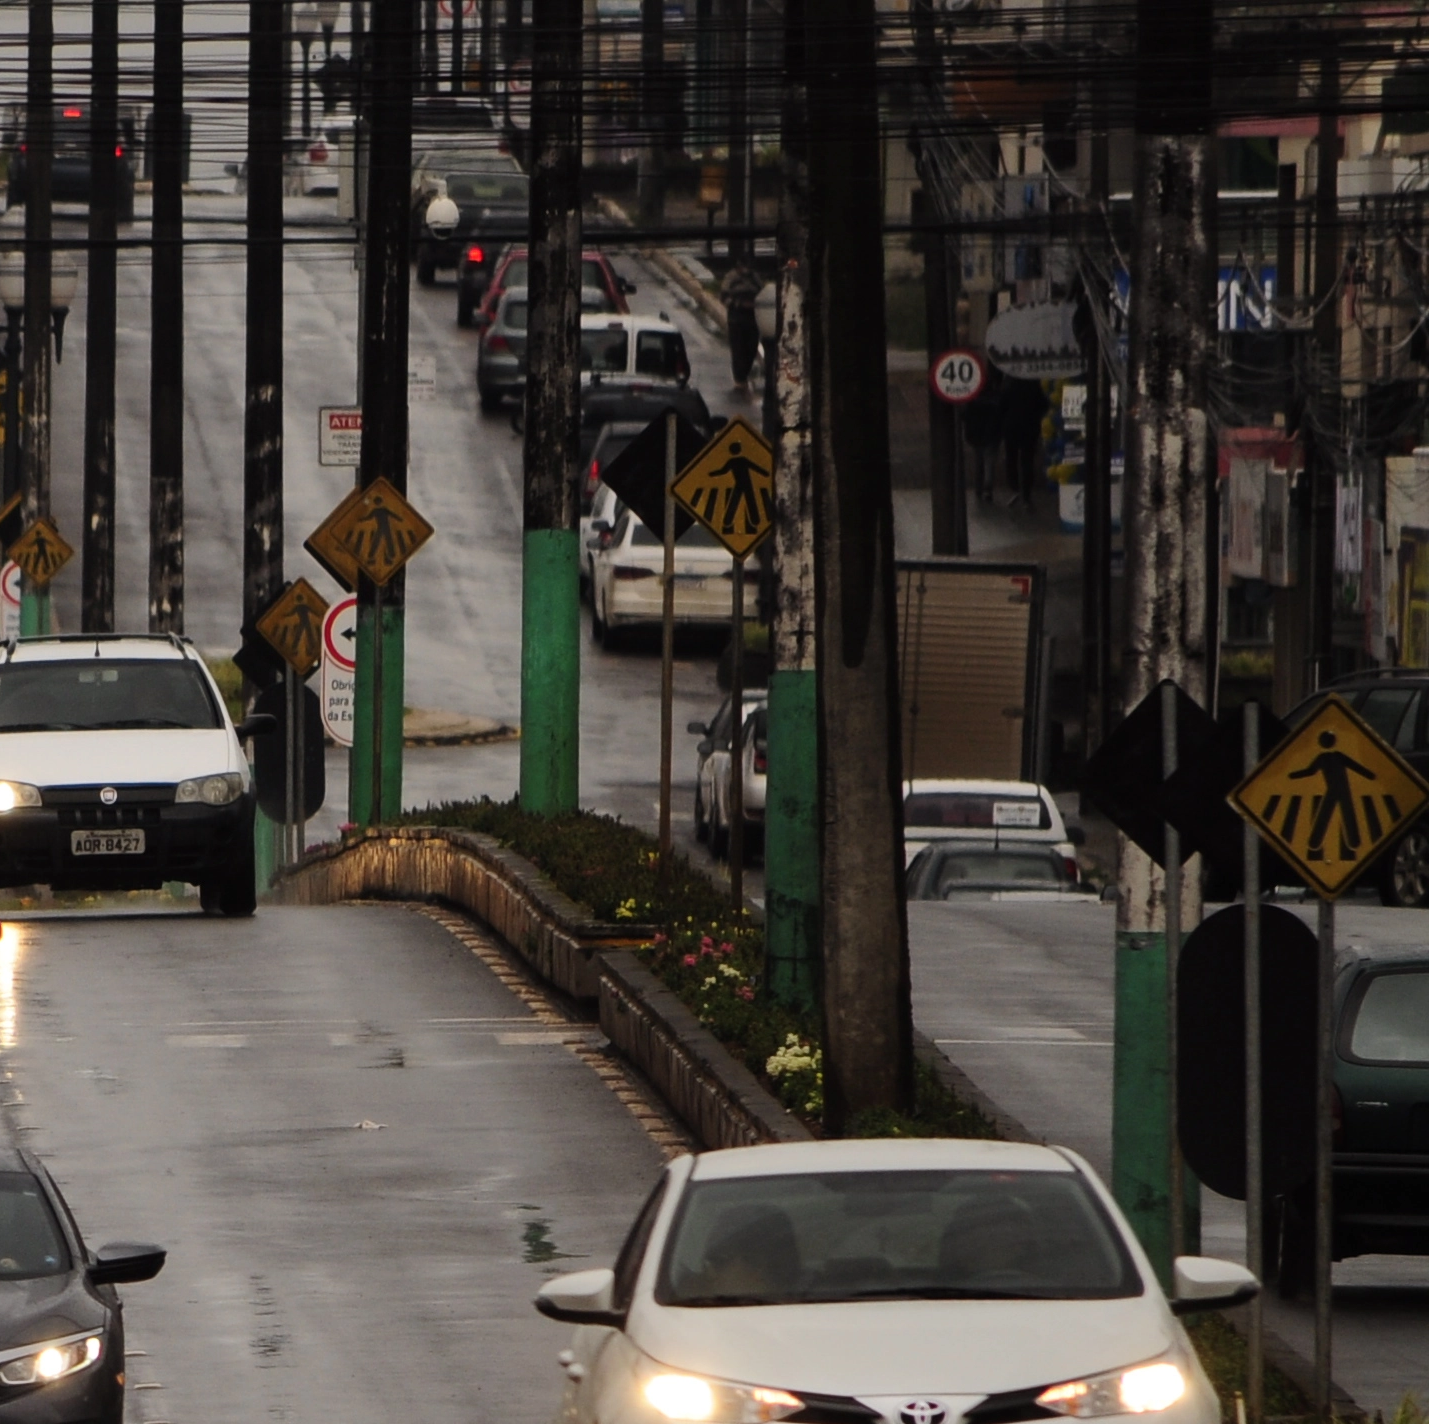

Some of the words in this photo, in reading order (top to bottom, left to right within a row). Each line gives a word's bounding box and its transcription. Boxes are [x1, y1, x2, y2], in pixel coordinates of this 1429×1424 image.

[941, 359, 974, 384] 40
[329, 697, 349, 707] para
[327, 711, 339, 721] da
